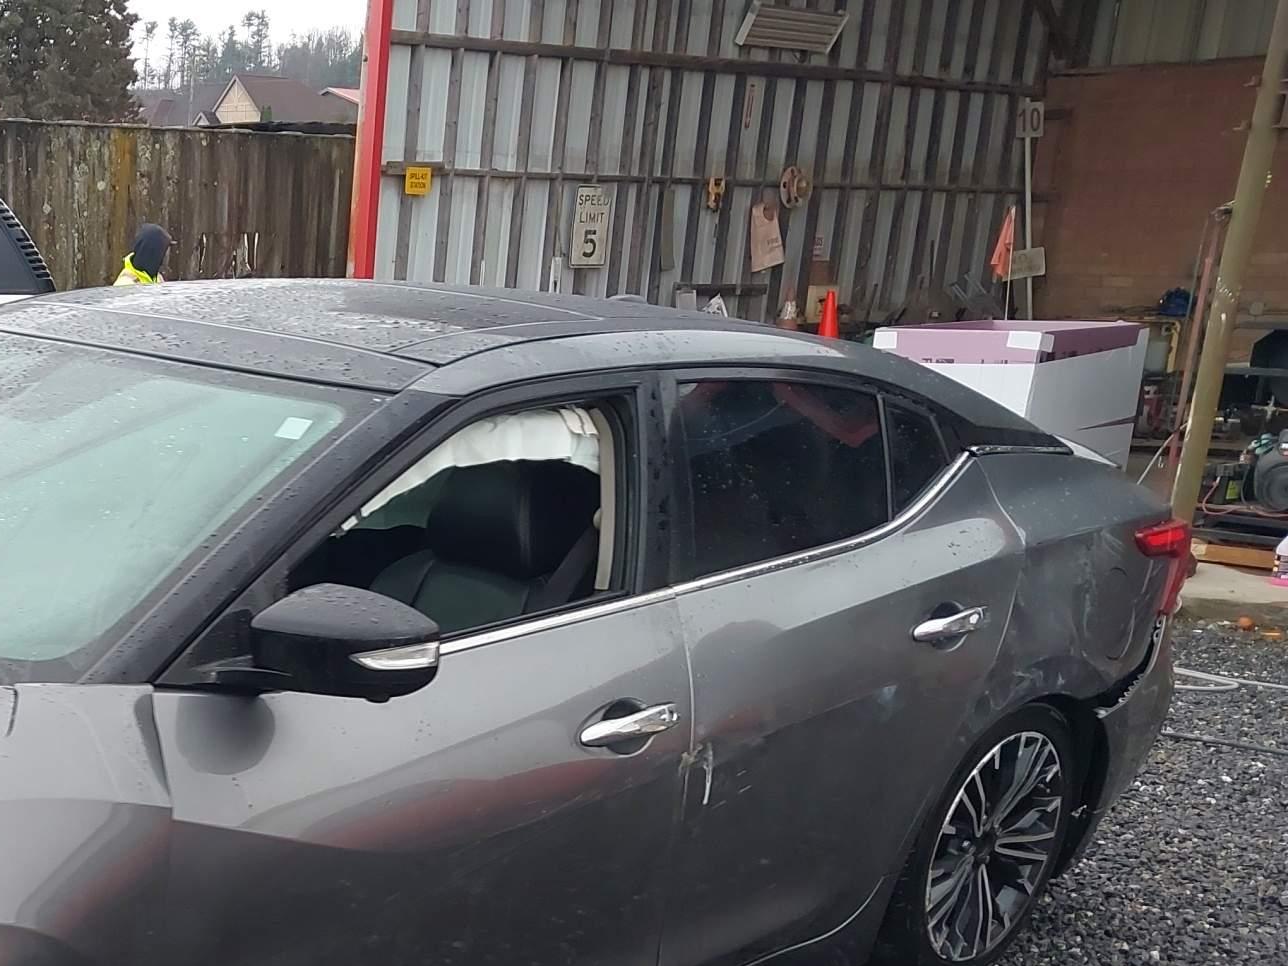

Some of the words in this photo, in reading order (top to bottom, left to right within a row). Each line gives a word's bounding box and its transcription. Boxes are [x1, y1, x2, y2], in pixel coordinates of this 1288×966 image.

[1018, 107, 1041, 132] 10
[578, 193, 611, 207] SPEED
[579, 211, 605, 224] LIMIT
[582, 229, 597, 258] 5
